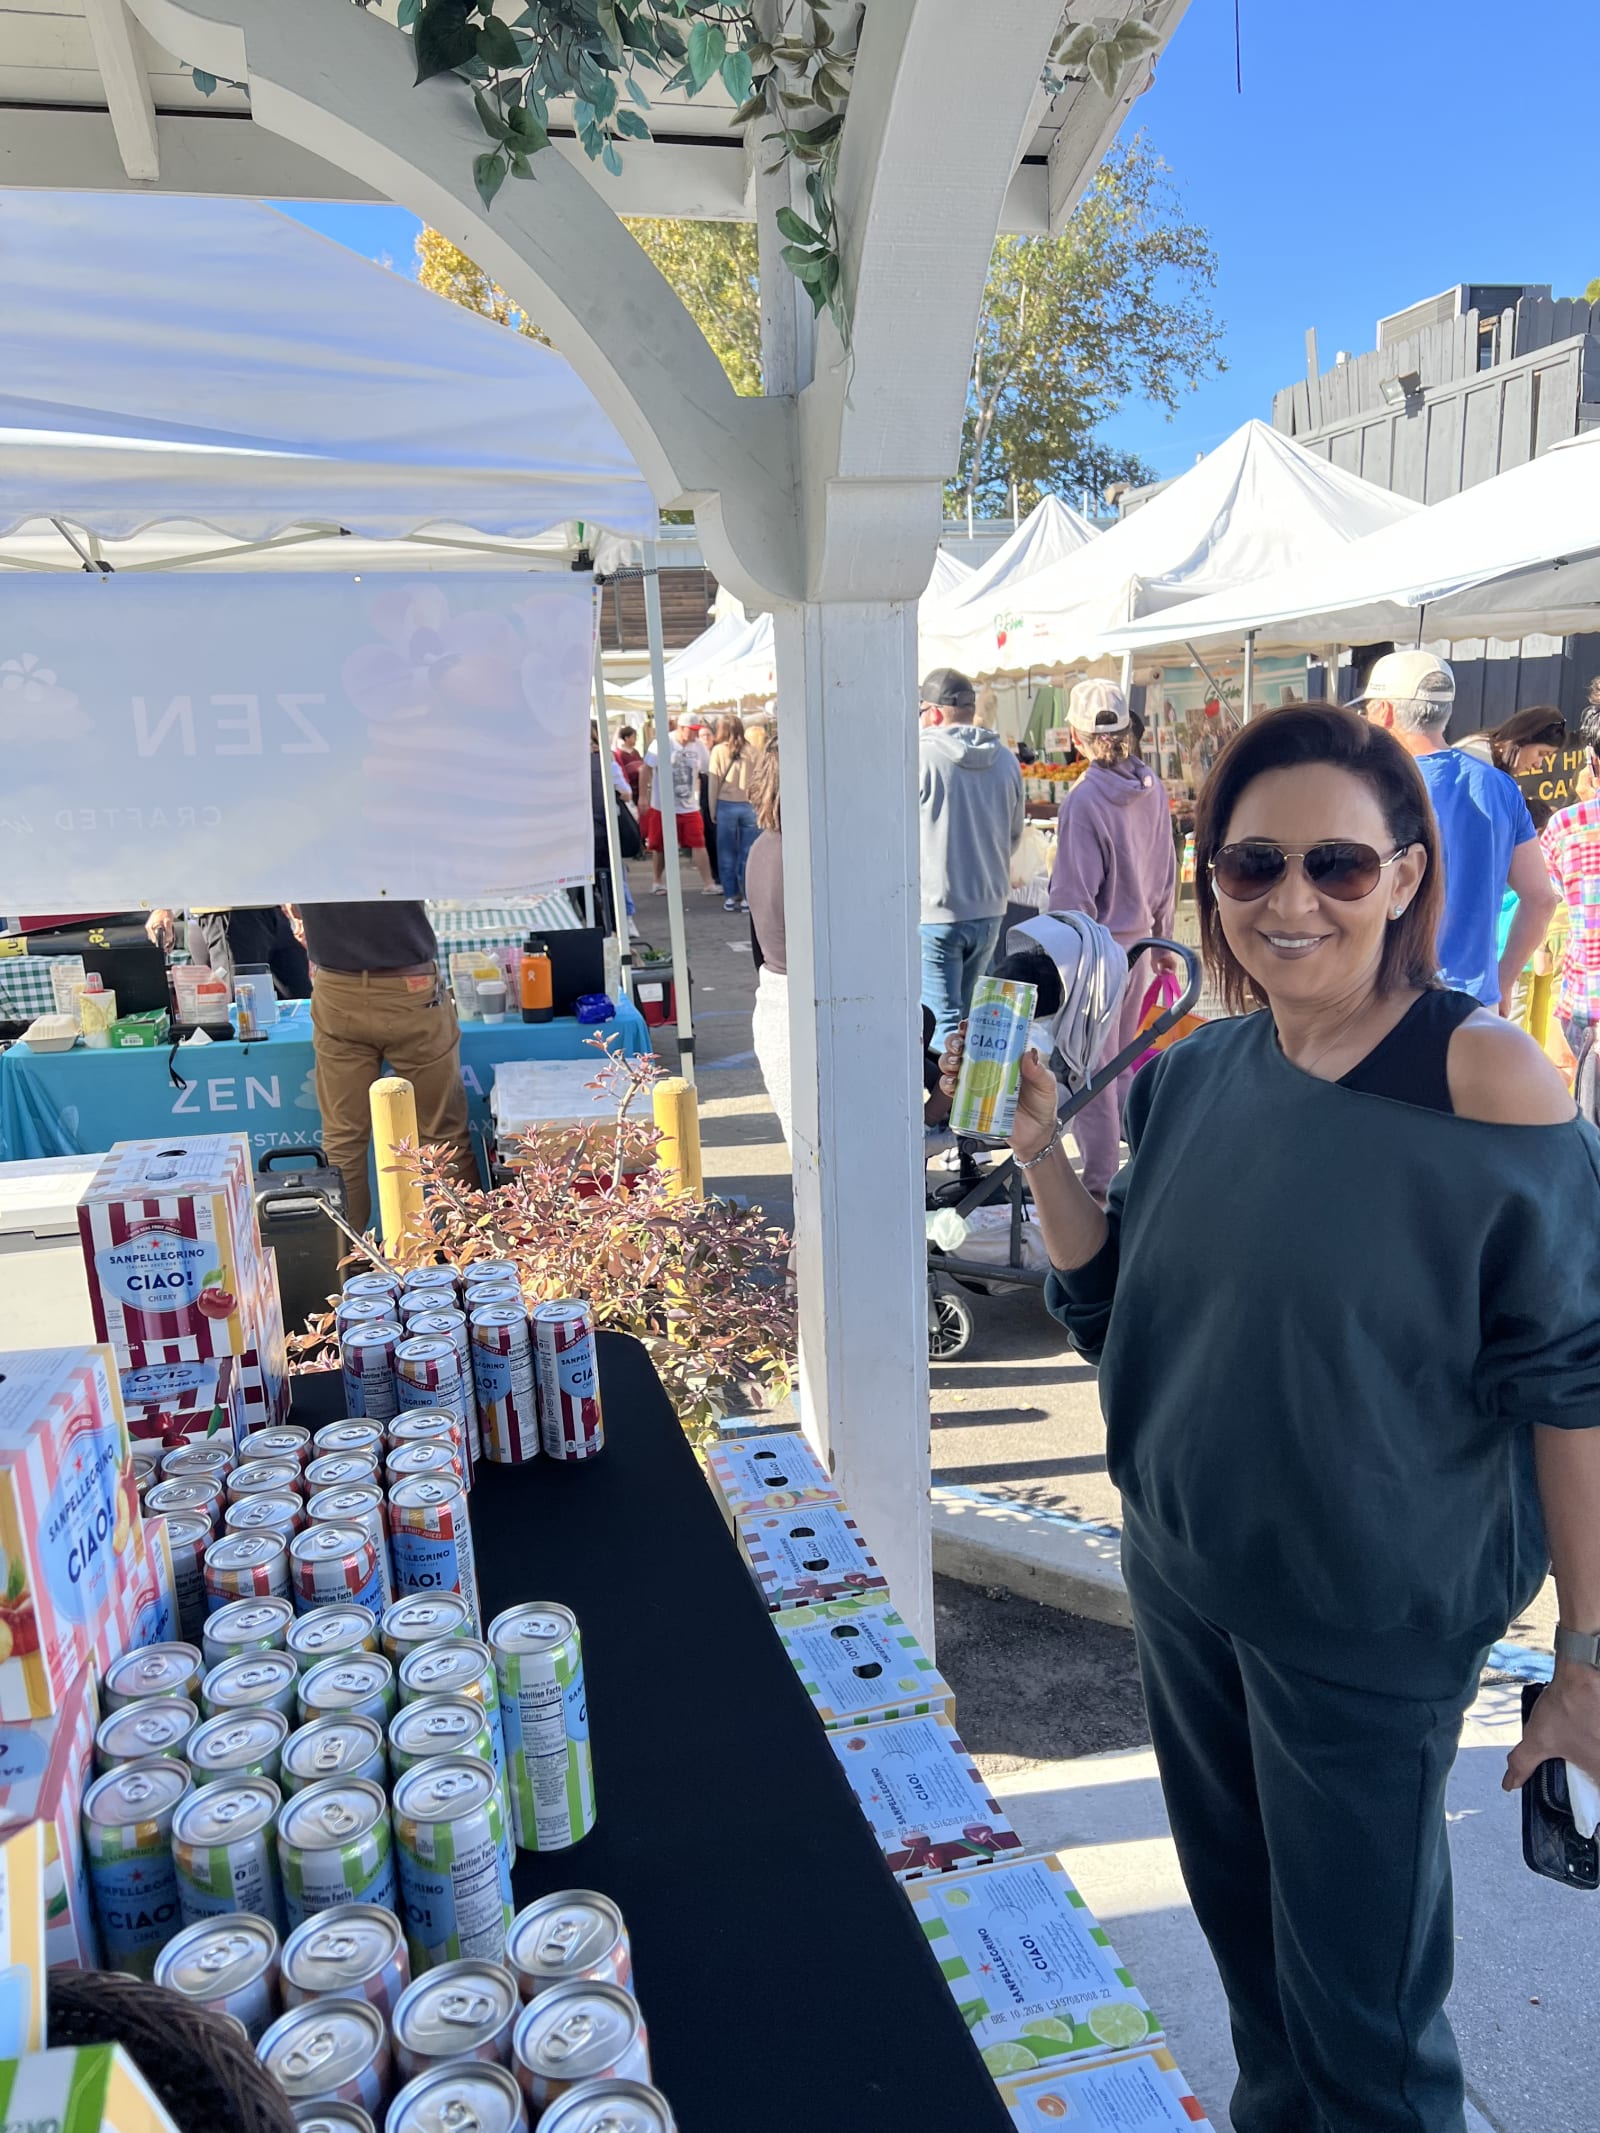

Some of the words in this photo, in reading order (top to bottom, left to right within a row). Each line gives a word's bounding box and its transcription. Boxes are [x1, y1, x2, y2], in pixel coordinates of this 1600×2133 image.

[168, 1074, 281, 1114] ZEN
[109, 1249, 205, 1264] SANPELLEGRINO
[127, 1271, 194, 1291] CIAO!
[148, 1294, 177, 1303] CHERRY
[571, 1367, 594, 1384] CIA
[48, 1443, 115, 1544] SANPELLEGRINO
[67, 1496, 115, 1585] CIAO!
[421, 1530, 442, 1539] JUICES
[806, 1541, 822, 1558] CIAO!
[840, 1638, 860, 1661] CIAO!
[858, 1621, 892, 1664] SANPELLEGRINO
[518, 1690, 545, 1700] Nutrition
[545, 1685, 561, 1696] Facts
[871, 1767, 907, 1826] SANPELLEGRINO
[905, 1772, 930, 1802] CIAO!
[451, 1856, 481, 1873] Nutrition
[481, 1843, 496, 1860] Facts
[331, 1890, 353, 1901] Facts
[1018, 1934, 1048, 1971] CIAO!
[977, 1928, 1025, 2004] SANPELLEGRINO
